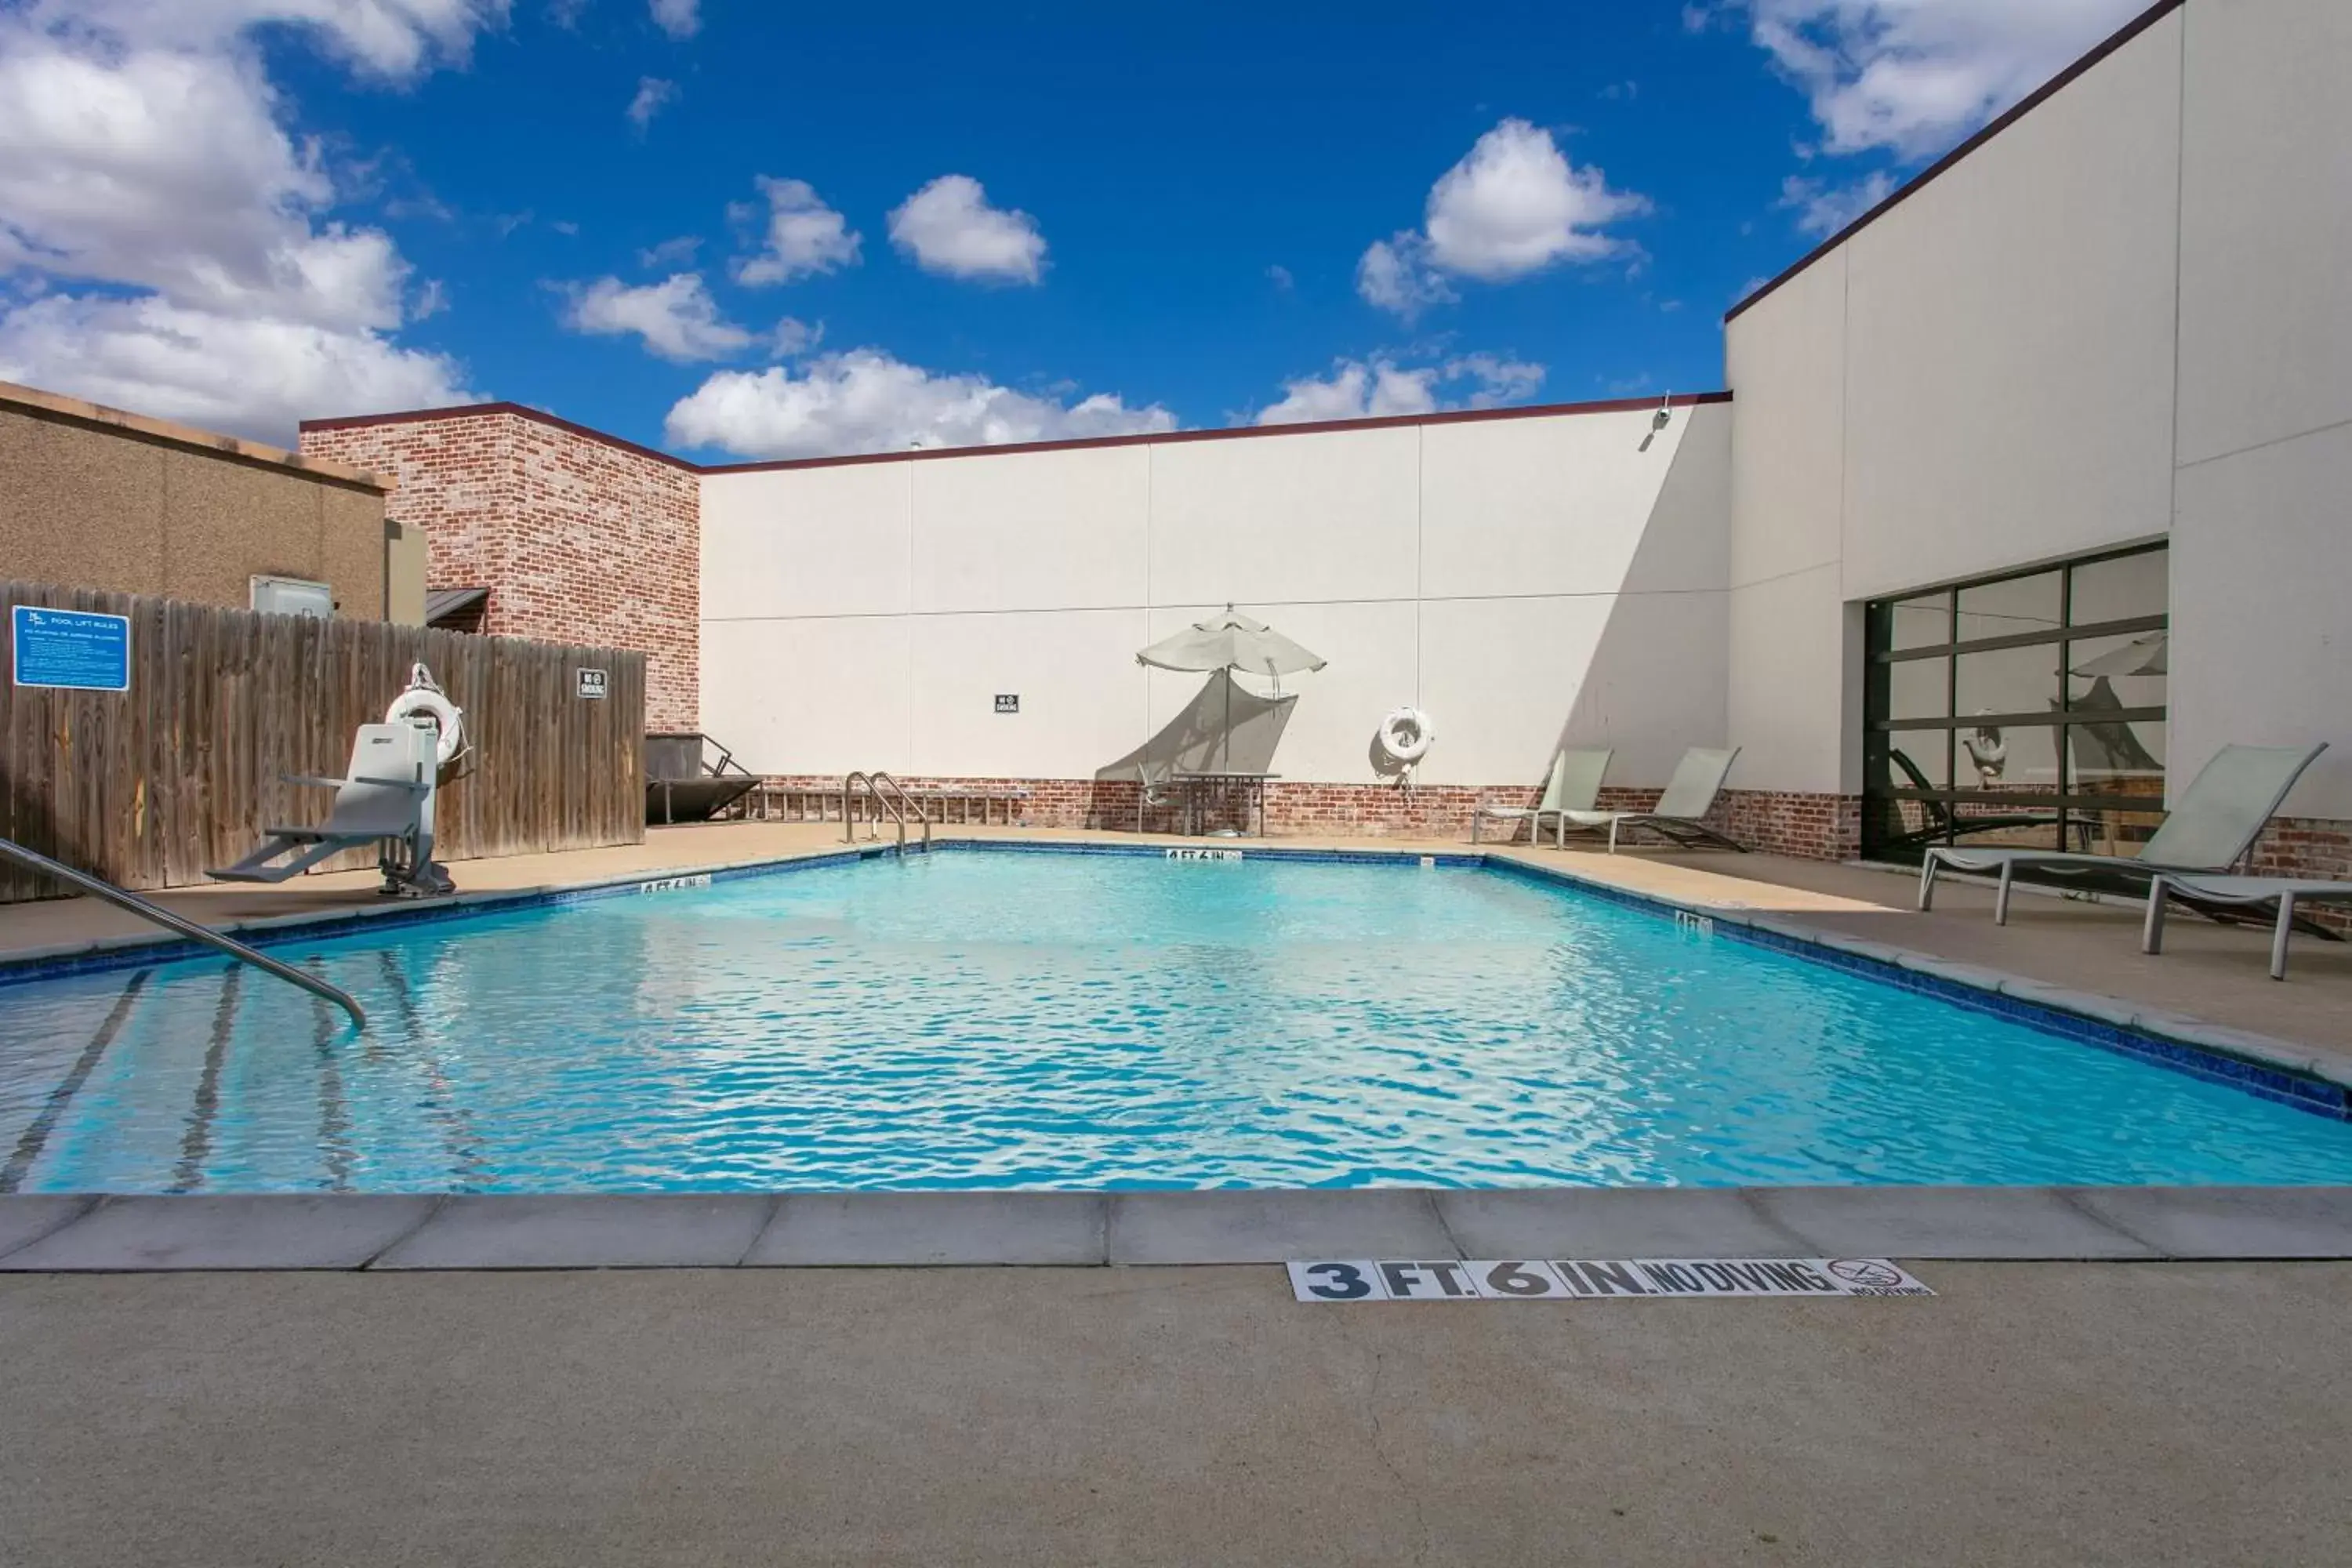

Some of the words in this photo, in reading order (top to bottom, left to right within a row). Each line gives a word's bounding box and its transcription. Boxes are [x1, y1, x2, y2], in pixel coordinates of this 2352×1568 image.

[584, 673, 592, 682] NO
[1307, 1263, 1371, 1299] 3
[1379, 1262, 1476, 1296] FT.
[1486, 1261, 1552, 1296] 6
[1555, 1261, 1659, 1294] IN.
[1640, 1262, 1705, 1293] NO
[1690, 1262, 1841, 1292] DIVING
